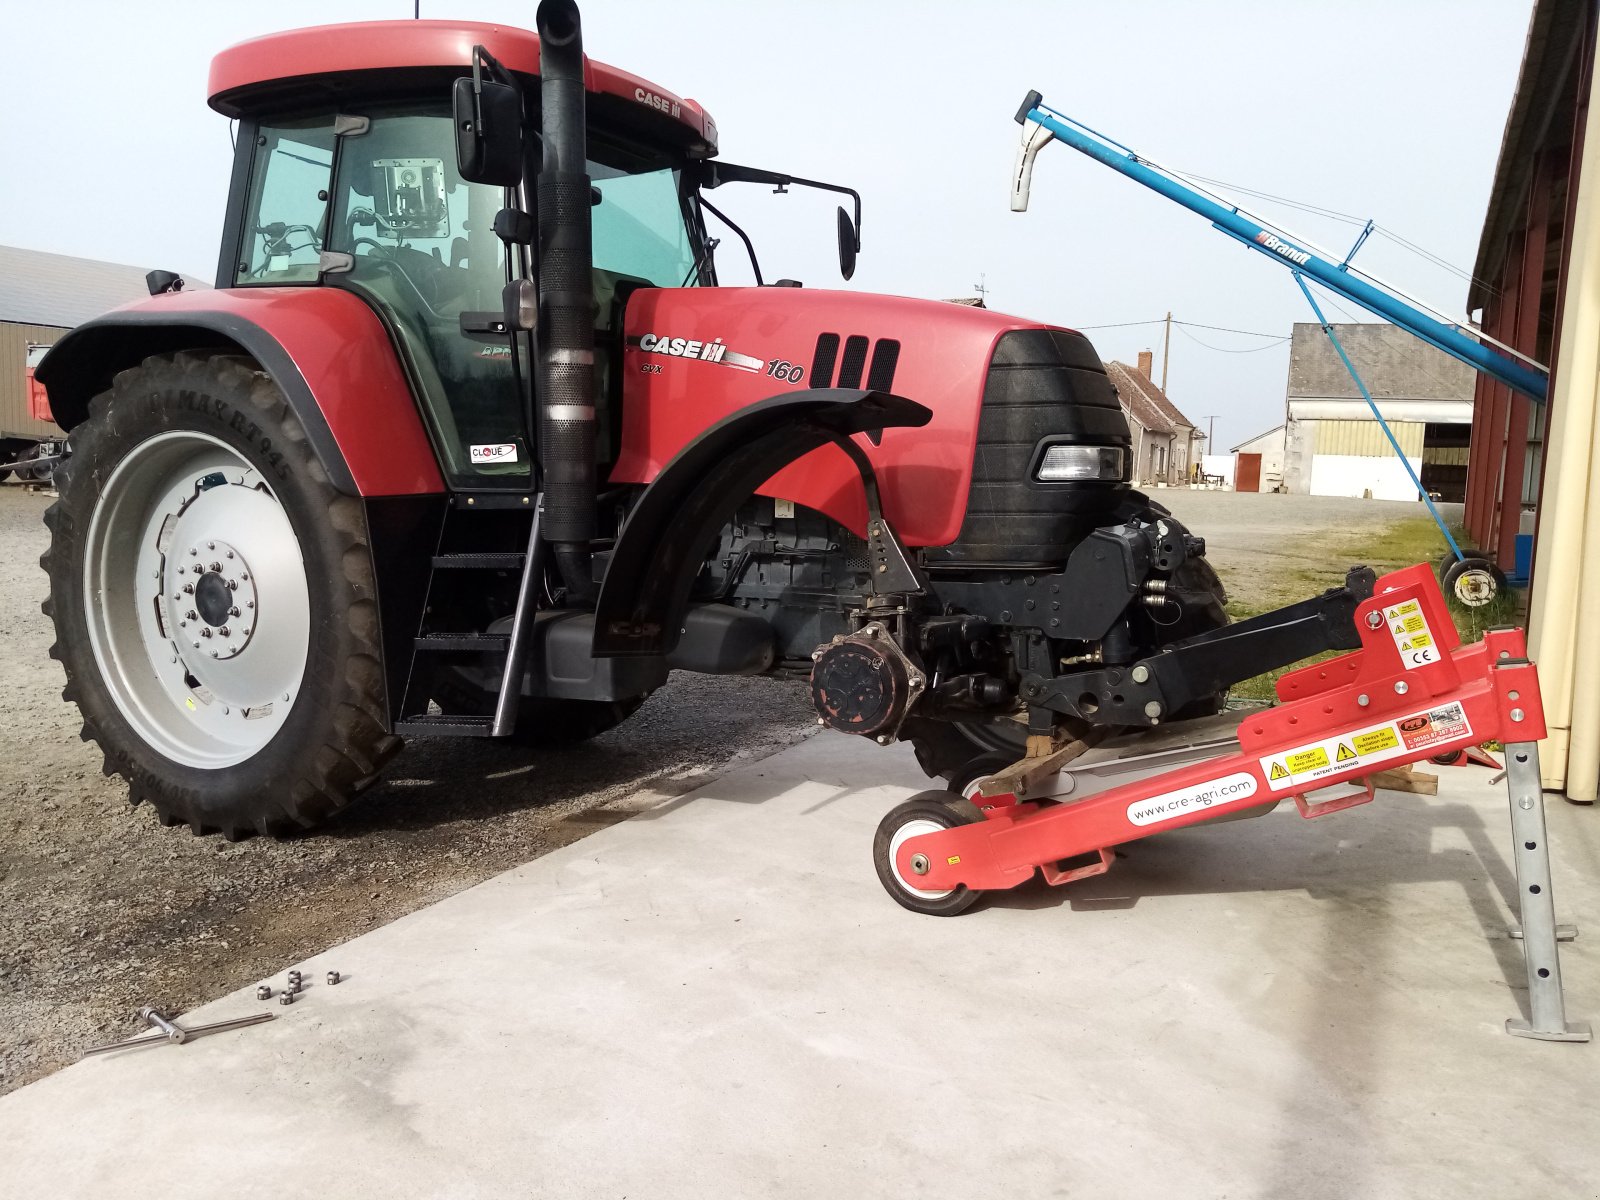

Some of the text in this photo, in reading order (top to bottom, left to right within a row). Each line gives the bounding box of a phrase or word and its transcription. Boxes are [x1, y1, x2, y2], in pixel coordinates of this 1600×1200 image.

[635, 87, 670, 114] CASE
[639, 333, 702, 359] CASE
[766, 359, 805, 384] 160
[1412, 649, 1432, 664] CE
[1294, 751, 1316, 762] Danger
[1313, 760, 1359, 776] PATENT PENDING
[1134, 780, 1251, 819] www.cre-agri.com
